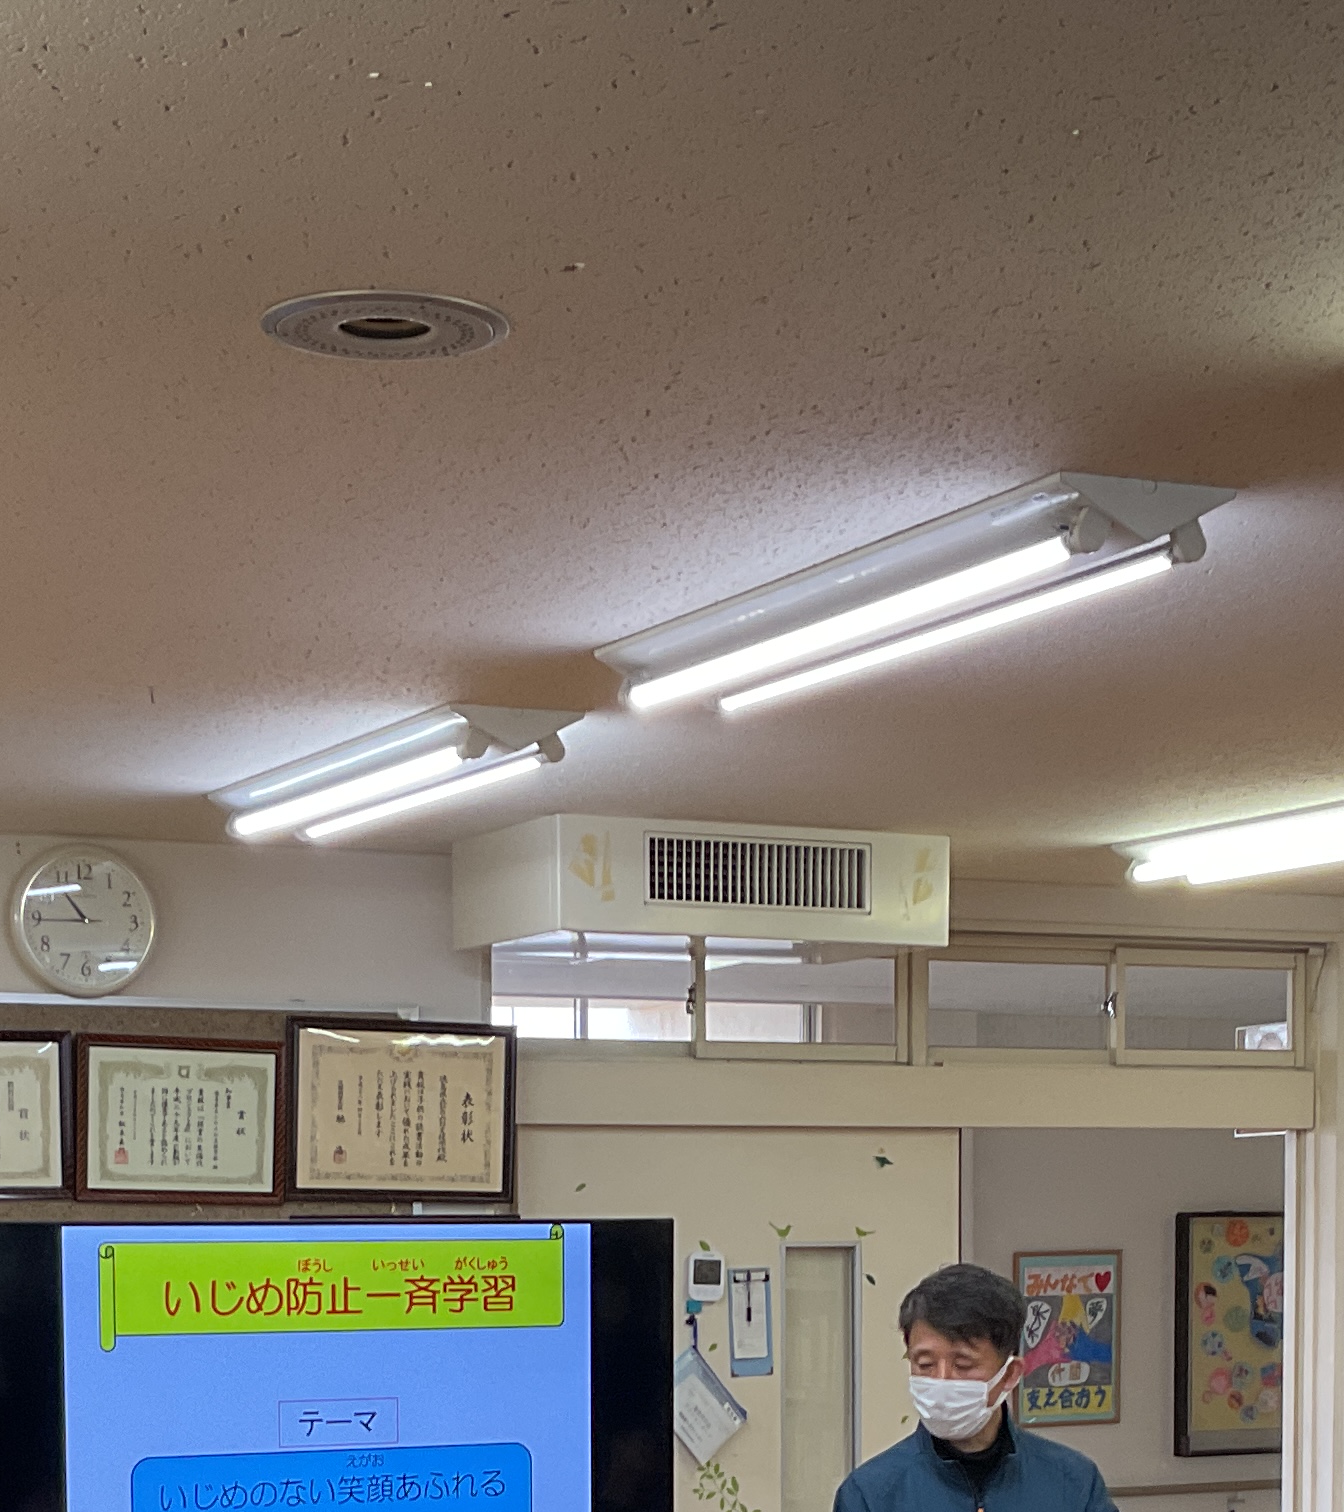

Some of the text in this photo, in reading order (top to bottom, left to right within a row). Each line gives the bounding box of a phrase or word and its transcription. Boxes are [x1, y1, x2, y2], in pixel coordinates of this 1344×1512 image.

[76, 863, 92, 881] 12
[122, 890, 132, 907] 2
[31, 909, 42, 927] 9
[129, 914, 139, 932] 3
[40, 934, 51, 953] 8
[59, 953, 71, 970] 7
[81, 960, 91, 977] 6
[461, 1091, 475, 1144] 表彰状
[297, 1255, 509, 1273] ぼうし いっせい がくしゅう
[164, 1275, 516, 1318] いじめ防止一斉学習
[297, 1408, 378, 1437] テーマ
[346, 1453, 385, 1468] えがお
[158, 1469, 507, 1512] いじめのない笑顔あふれる
